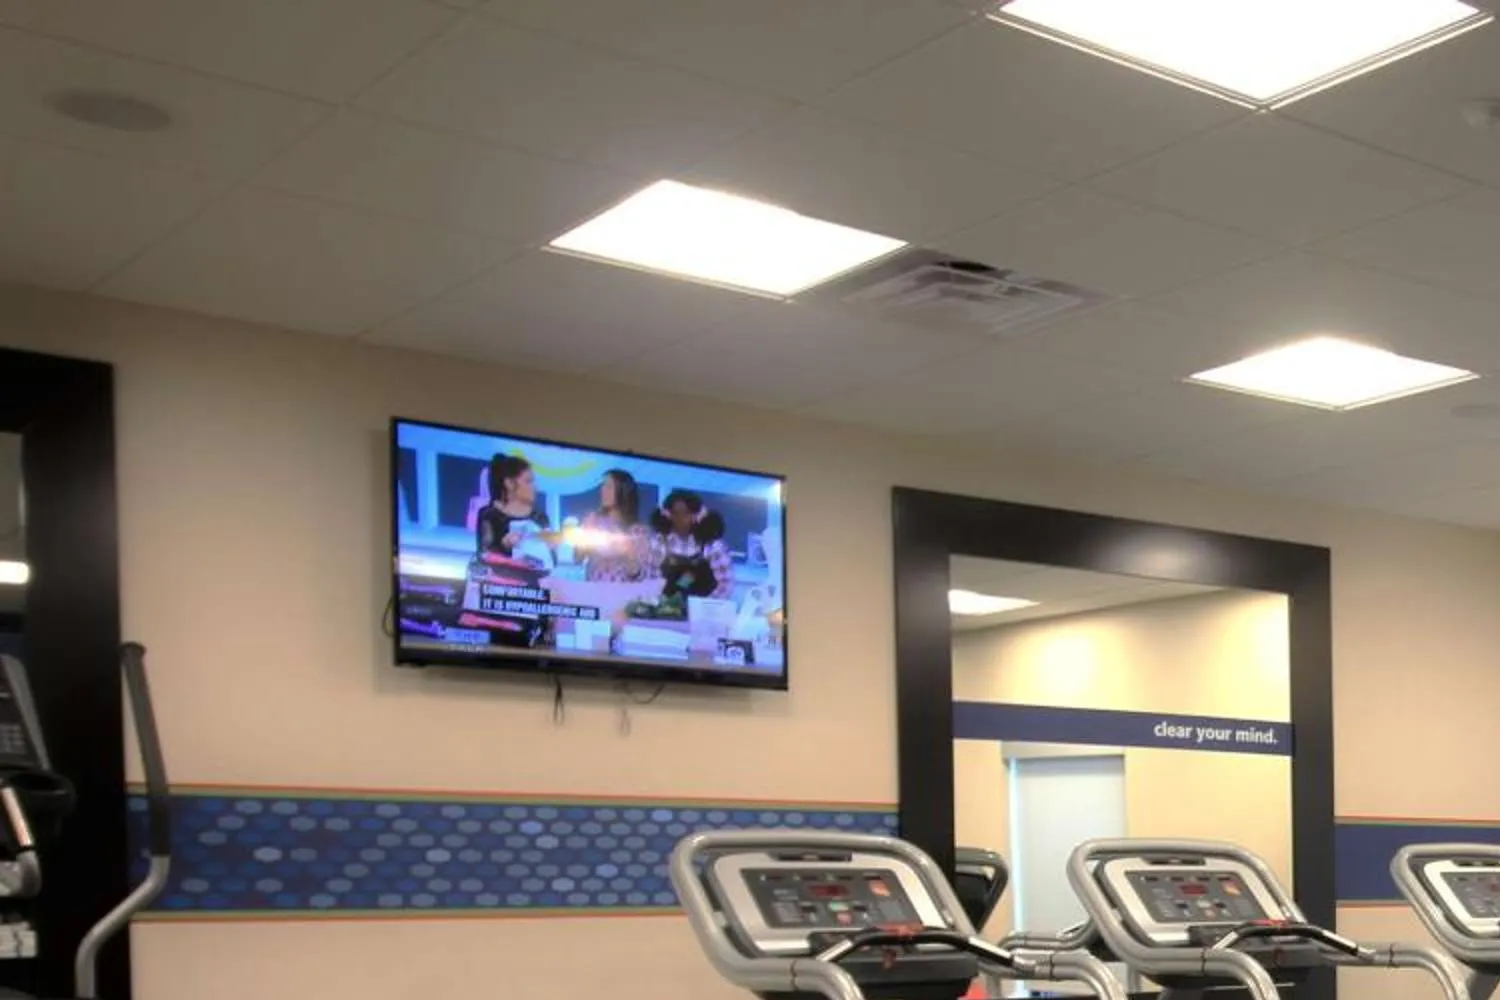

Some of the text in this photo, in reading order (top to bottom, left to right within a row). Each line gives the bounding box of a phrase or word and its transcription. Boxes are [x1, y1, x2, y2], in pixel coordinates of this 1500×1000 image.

[1153, 721, 1278, 744] clear your mind.
